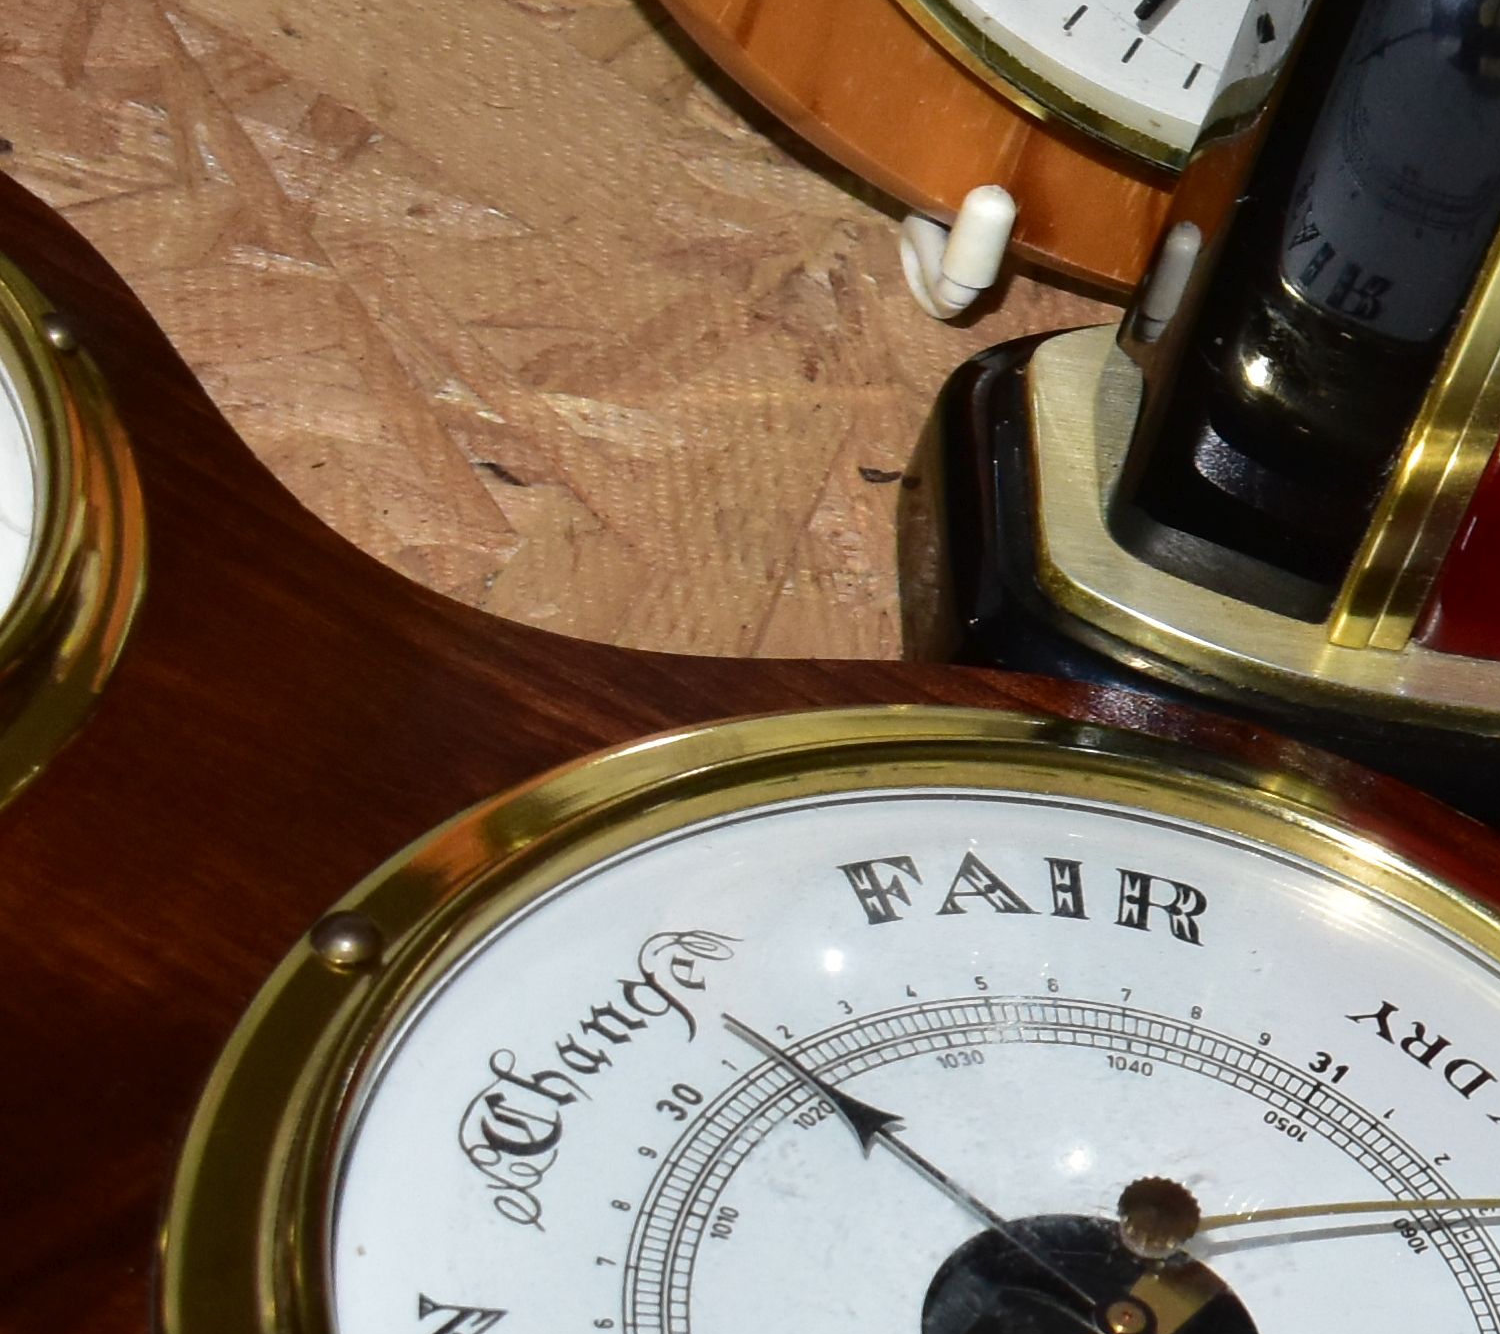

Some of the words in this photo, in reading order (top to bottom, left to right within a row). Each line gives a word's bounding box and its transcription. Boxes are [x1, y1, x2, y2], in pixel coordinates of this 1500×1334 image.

[837, 851, 1208, 947] FAIR
[974, 976, 989, 990] 5
[1121, 988, 1132, 1002] 7
[1191, 1005, 1203, 1020] 8
[1258, 1032, 1272, 1046] 9
[1345, 1000, 1498, 1101] DRY
[460, 930, 738, 1215] Change
[935, 1049, 985, 1070] 1030
[1106, 1054, 1154, 1077] 1040
[1308, 1051, 1350, 1084] 31
[656, 1083, 704, 1121] 30
[792, 1099, 837, 1131] 1020
[1263, 1110, 1309, 1143] 1050
[611, 1199, 632, 1212] 8
[710, 1206, 740, 1240] 1010
[1393, 1217, 1429, 1255] 1060
